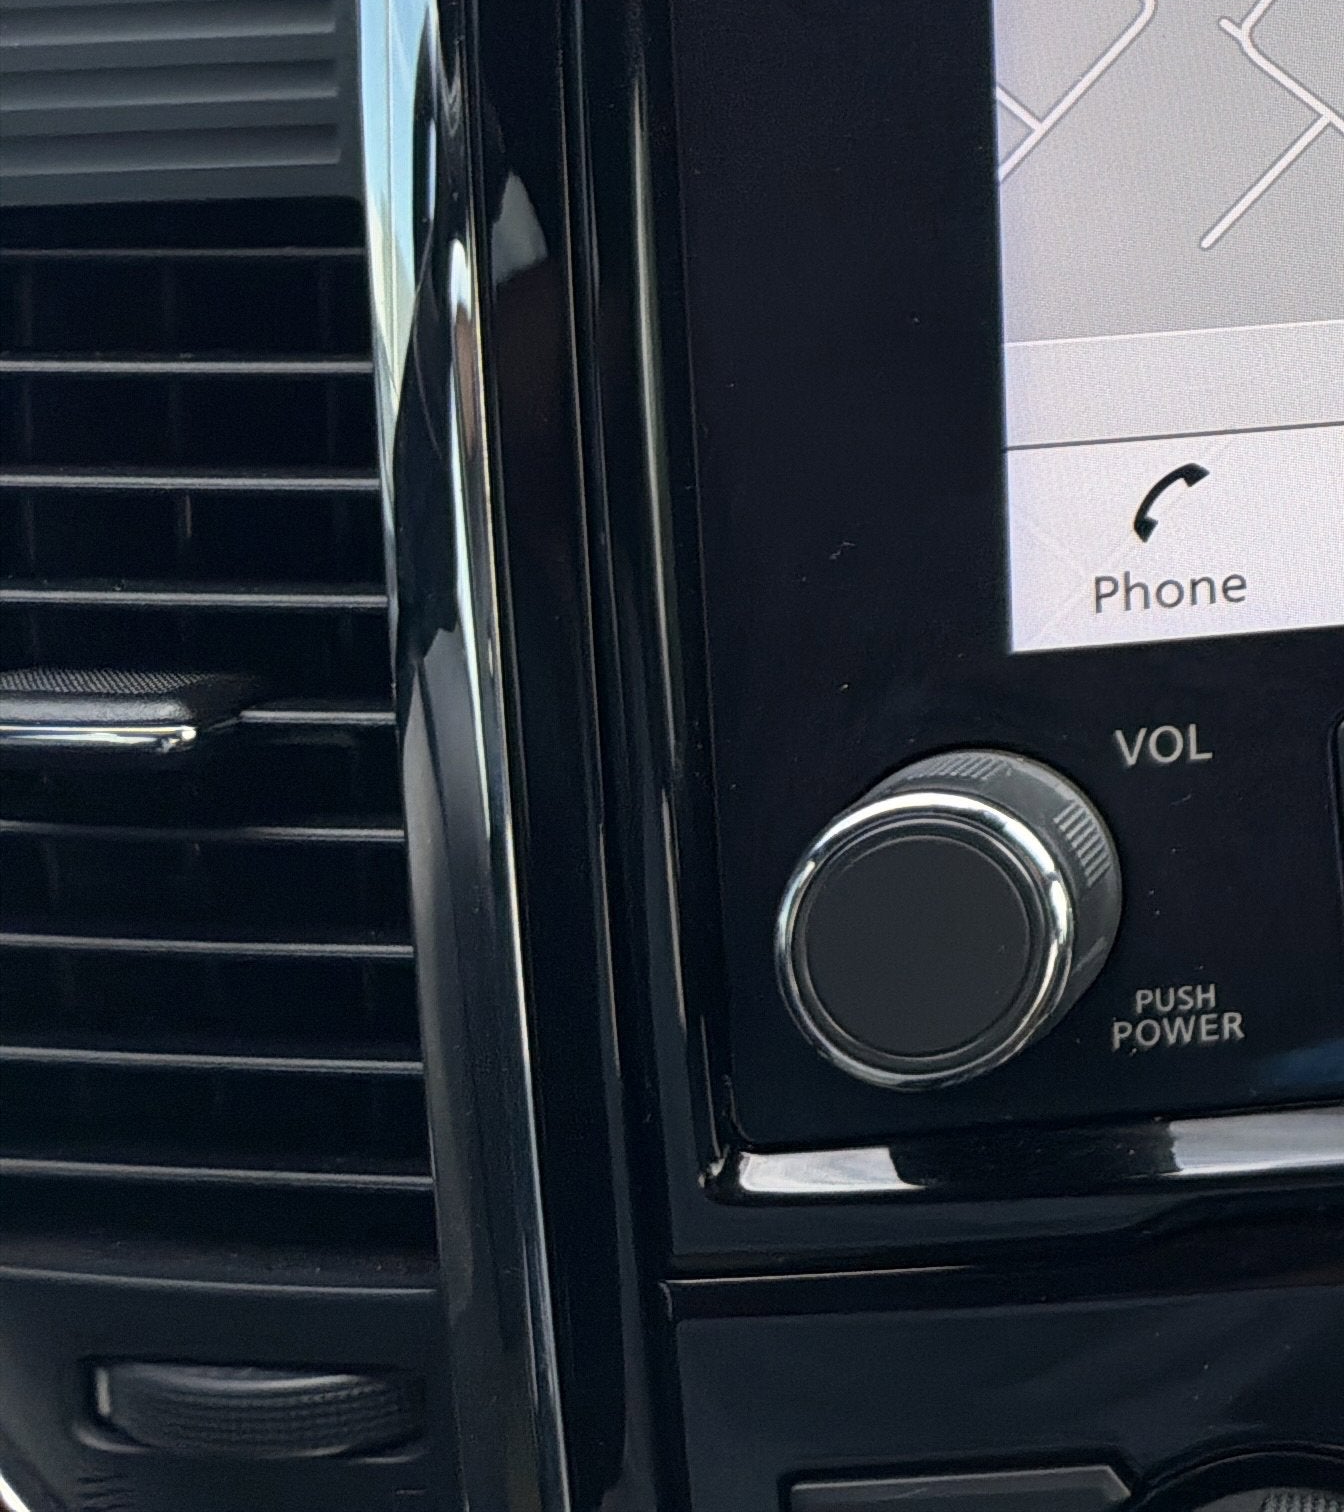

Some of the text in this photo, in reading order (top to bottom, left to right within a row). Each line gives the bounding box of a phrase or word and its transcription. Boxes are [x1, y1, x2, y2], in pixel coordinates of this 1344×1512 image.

[1093, 569, 1248, 614] Phone
[1114, 724, 1214, 769] VOL
[1134, 982, 1217, 1014] PUSH
[1111, 1010, 1244, 1050] POWER
